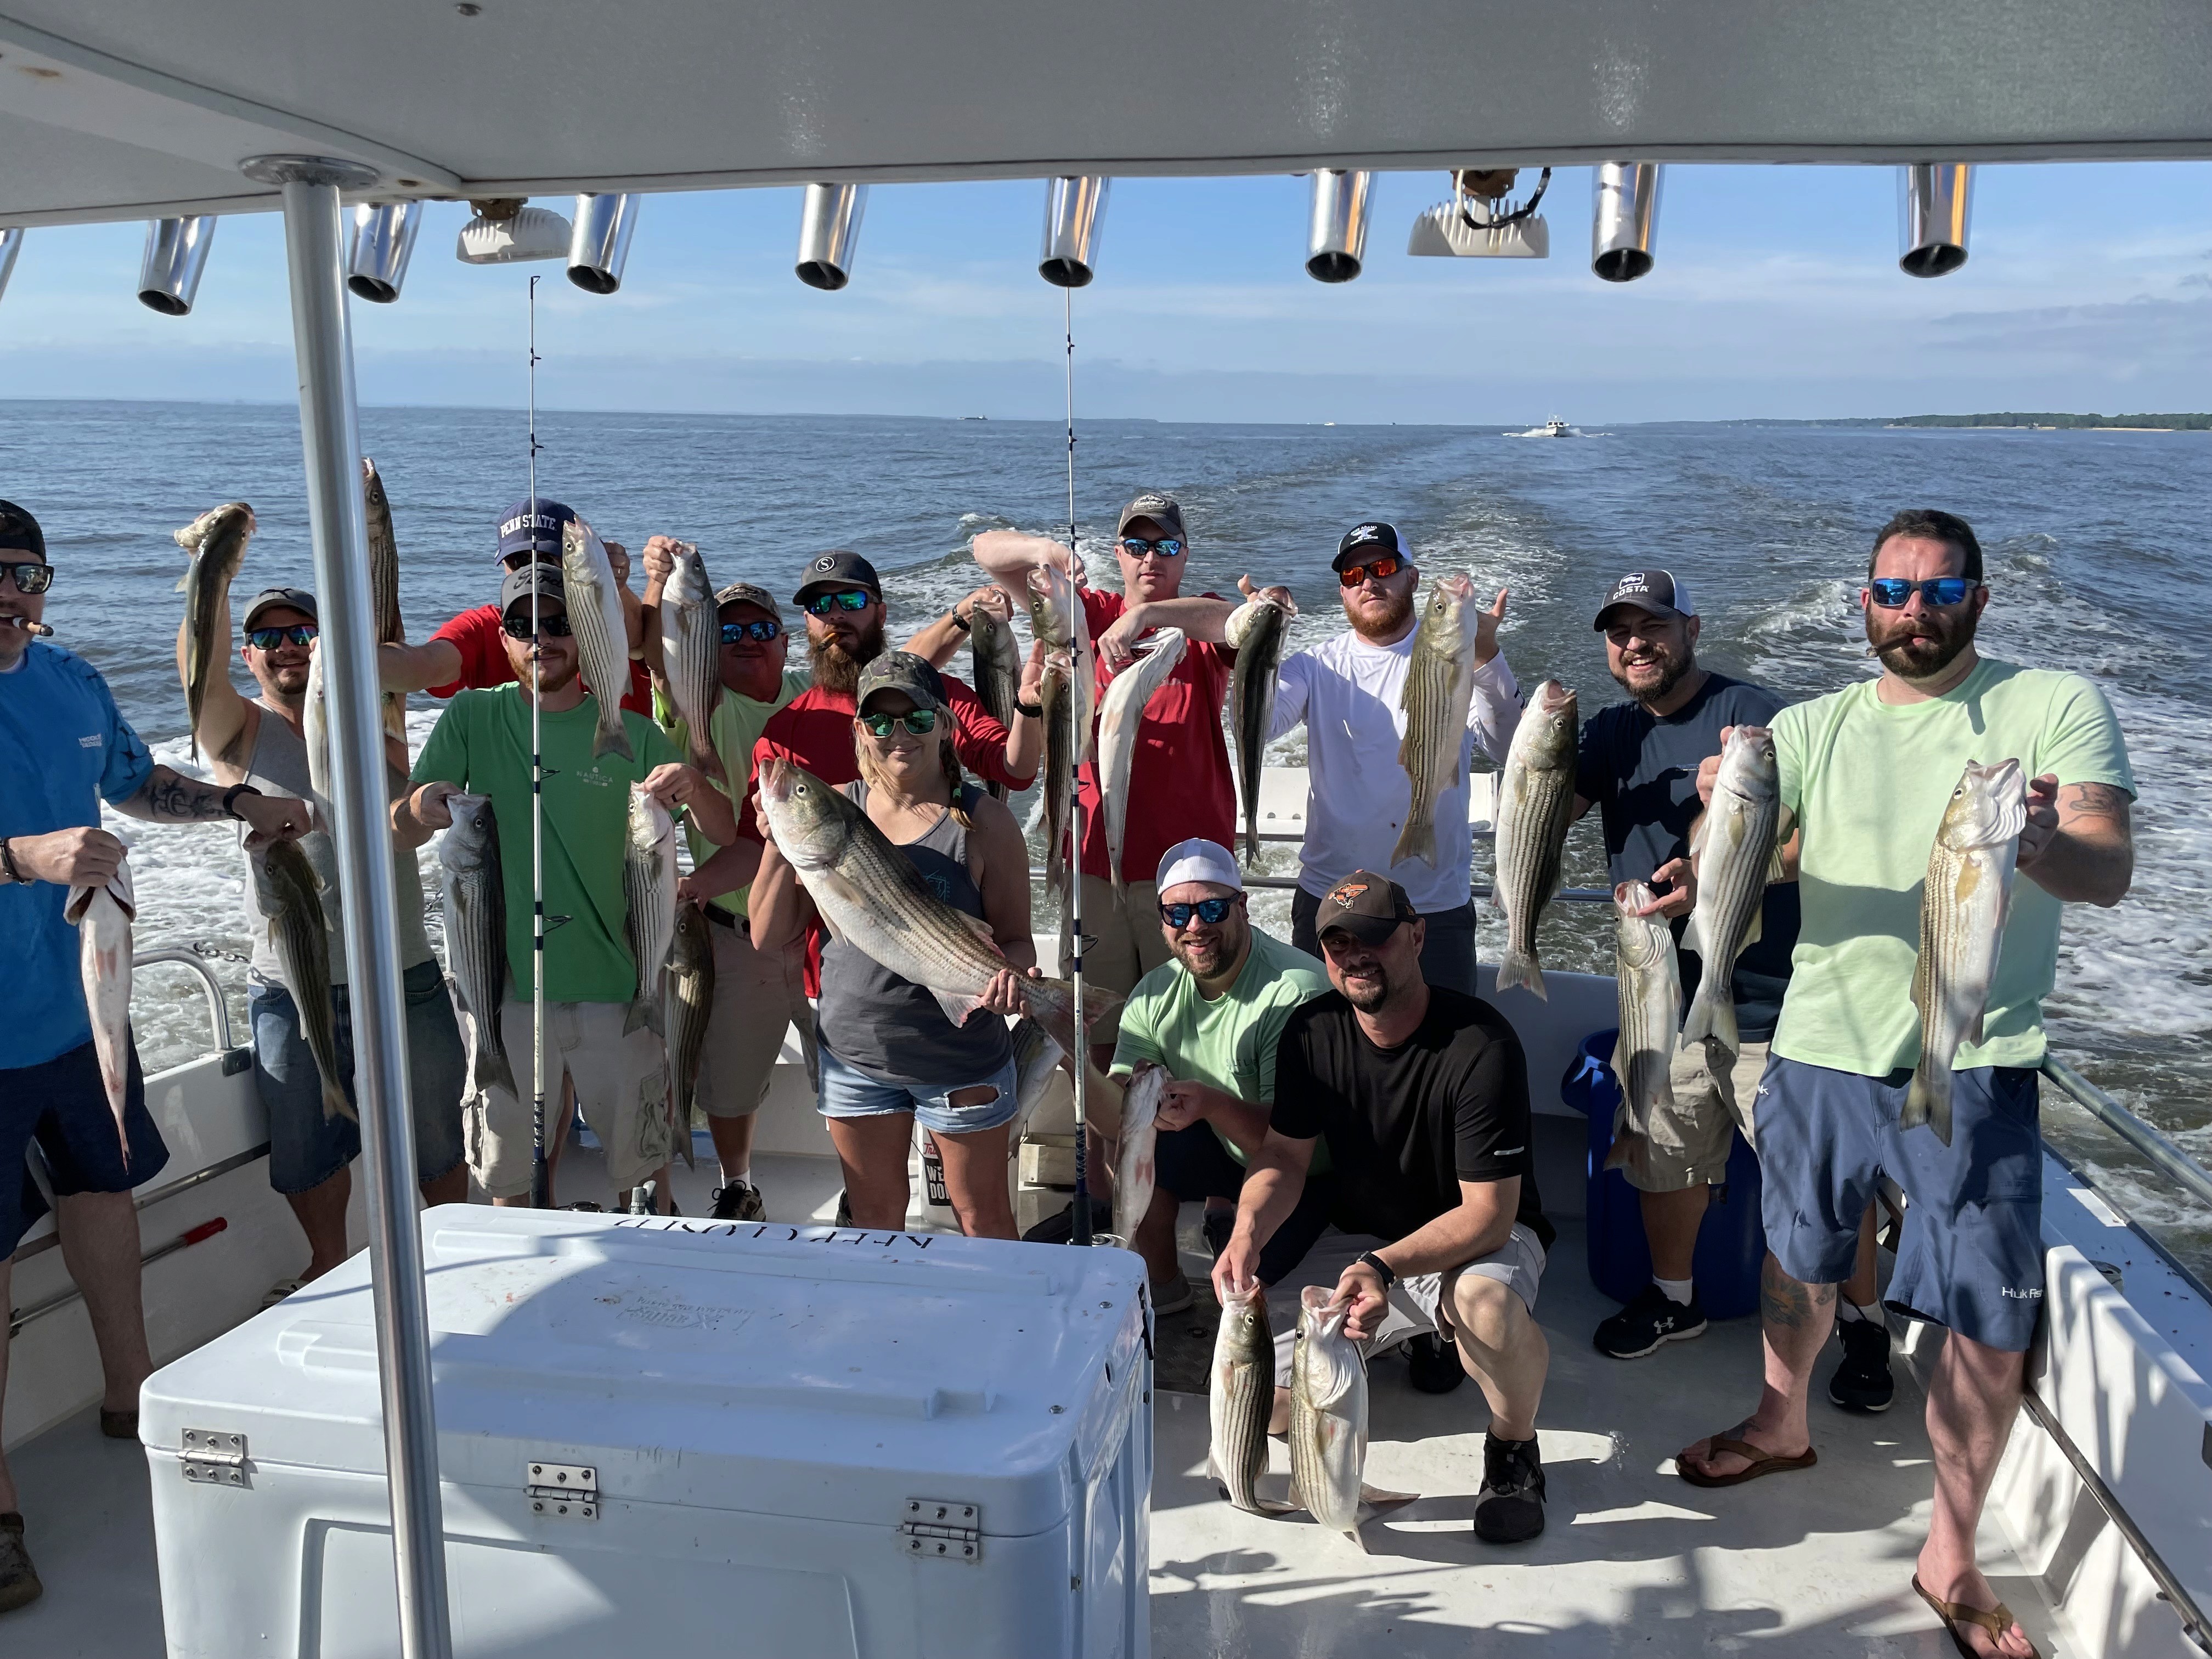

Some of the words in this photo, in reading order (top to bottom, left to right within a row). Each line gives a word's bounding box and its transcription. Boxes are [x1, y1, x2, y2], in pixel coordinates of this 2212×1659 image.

[500, 516, 521, 538] PENN
[1613, 585, 1648, 600] COSTA
[577, 771, 613, 783] NAUTICA
[926, 1165, 944, 1181] WE
[2002, 1286, 2028, 1299] Huk
